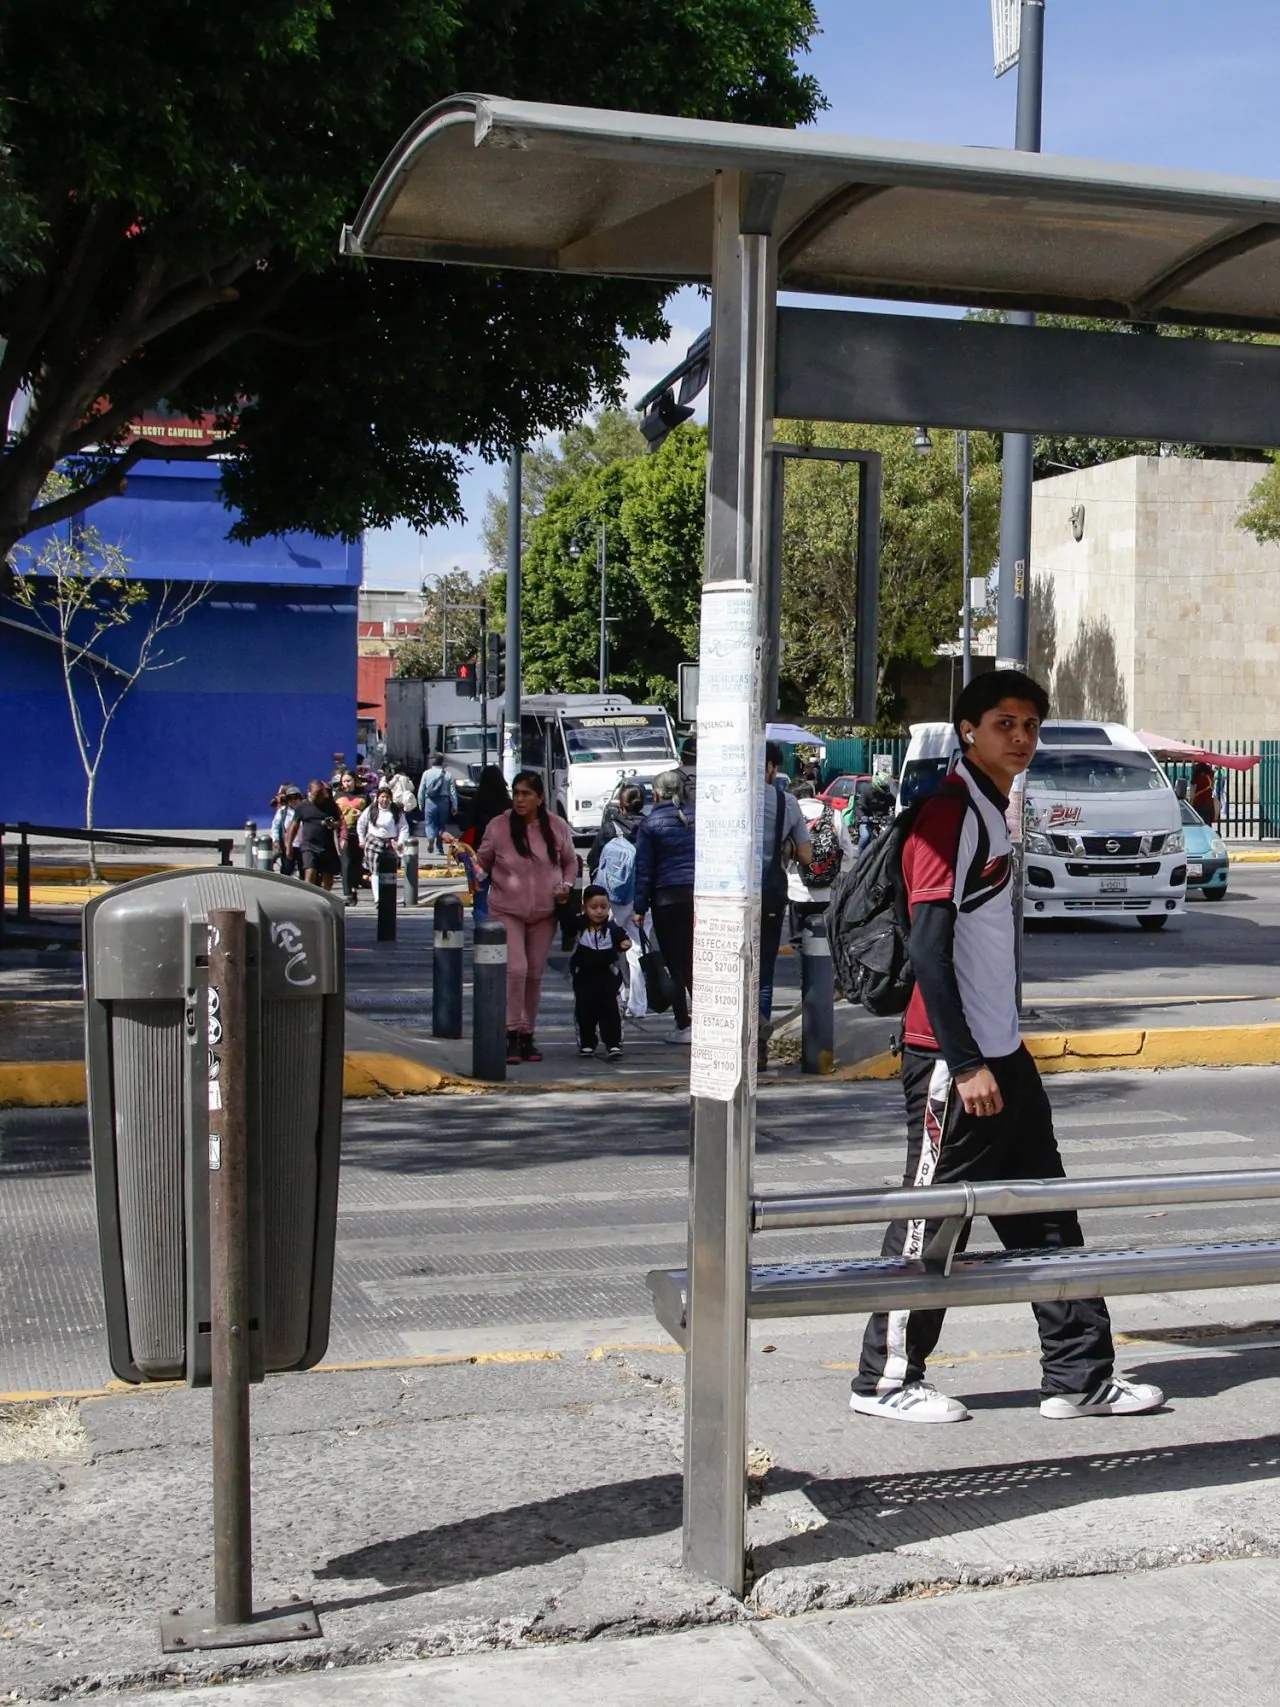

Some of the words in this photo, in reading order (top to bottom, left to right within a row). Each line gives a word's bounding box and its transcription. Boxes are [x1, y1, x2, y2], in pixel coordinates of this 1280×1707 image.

[142, 426, 165, 436] SCOTT
[714, 995, 737, 1006] $1200
[703, 1016, 735, 1029] ESTACAS
[713, 1060, 735, 1071] $1100
